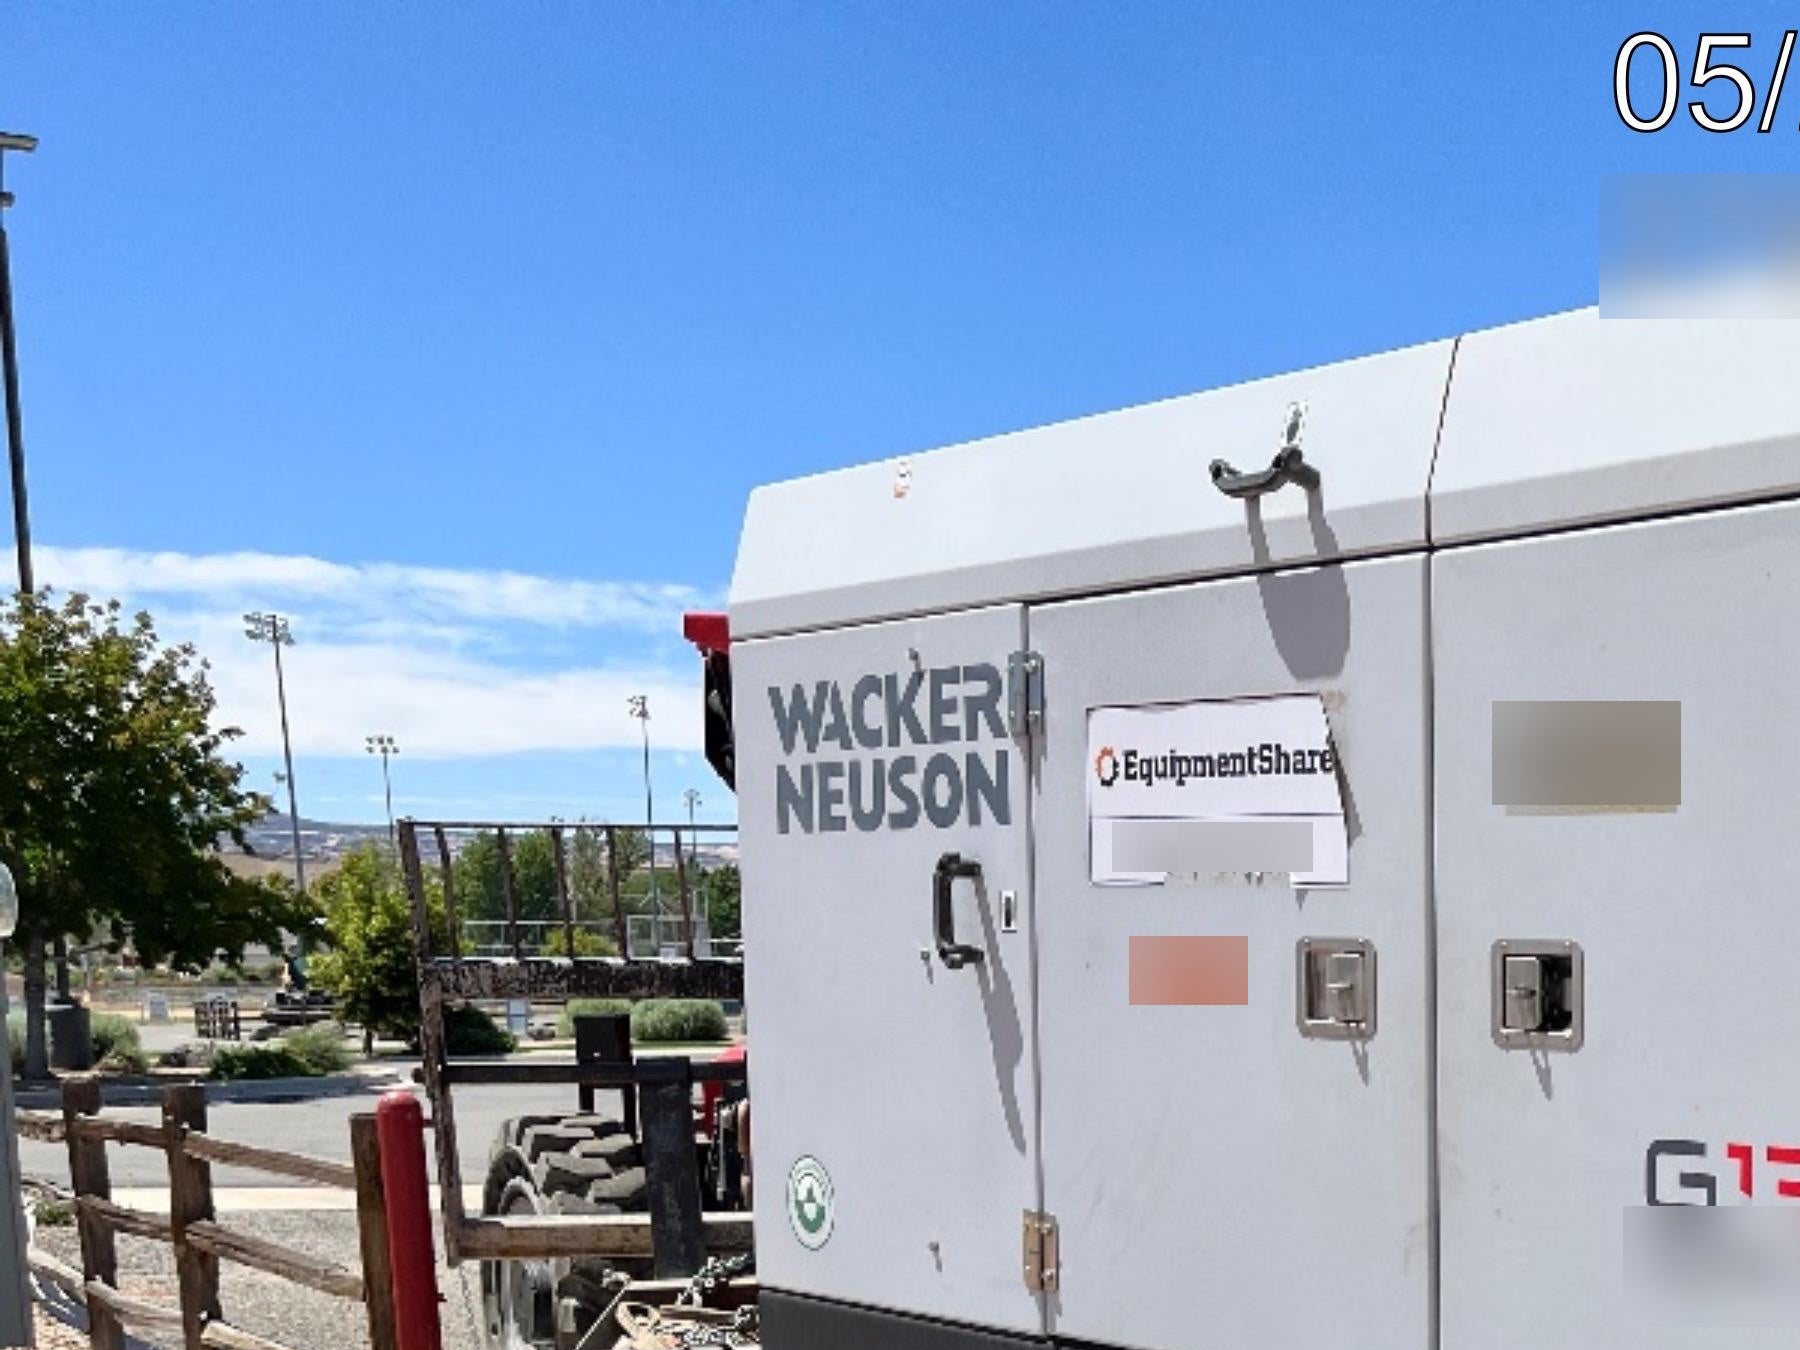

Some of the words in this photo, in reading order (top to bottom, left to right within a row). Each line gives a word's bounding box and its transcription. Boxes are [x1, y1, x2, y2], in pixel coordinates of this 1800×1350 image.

[767, 663, 1008, 752] WACKER
[774, 748, 1012, 835] NEUSON
[1123, 741, 1335, 788] EquipmentShare
